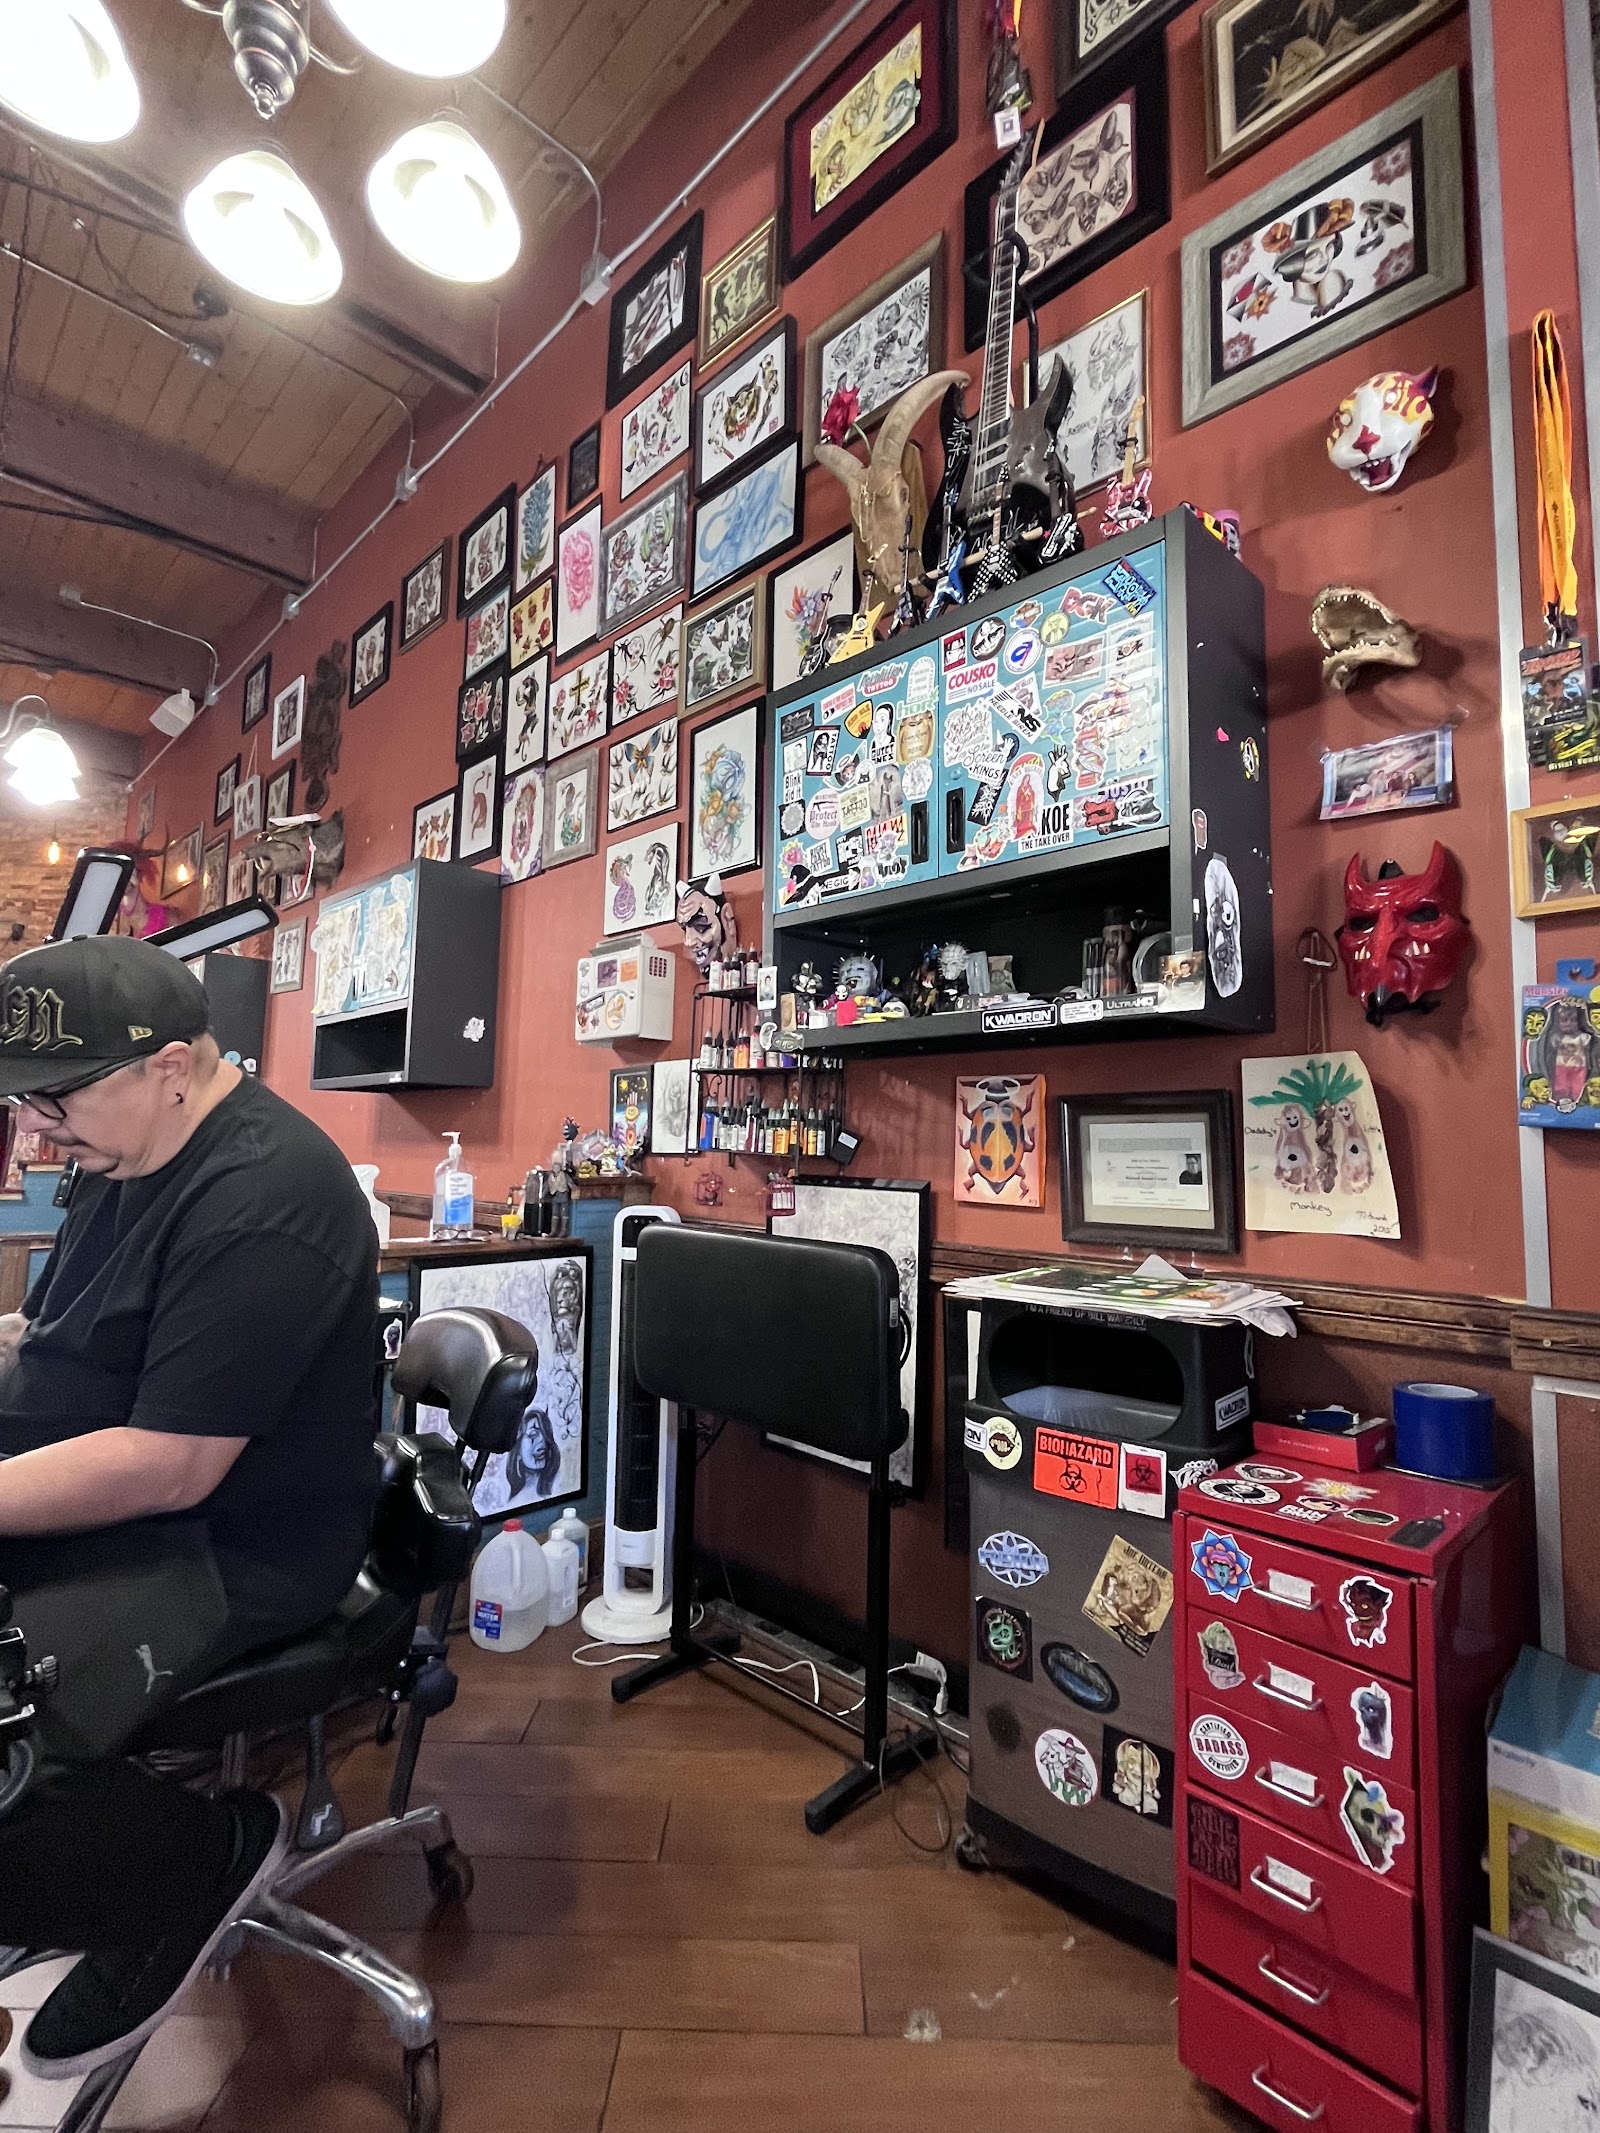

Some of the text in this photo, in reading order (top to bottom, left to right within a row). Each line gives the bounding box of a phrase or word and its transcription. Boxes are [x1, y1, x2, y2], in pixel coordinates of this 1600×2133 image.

[948, 662, 996, 690] COUSKO
[866, 679, 894, 693] TATTOO
[967, 680, 996, 694] NO SALE
[1012, 720, 1034, 738] SIREN
[825, 732, 838, 771] TATTOO
[963, 745, 1004, 767] Screen
[973, 763, 1000, 779] KINGS
[784, 772, 802, 789] Blink
[809, 810, 838, 822] Protect
[841, 798, 868, 818] TATTOO
[1021, 832, 1070, 850] THE TAKE OVER
[834, 877, 849, 887] GIG
[985, 1009, 1051, 1028] KWADRON
[1244, 1126, 1277, 1138] Daddy's
[1289, 1201, 1332, 1217] Monkey
[1373, 1224, 1391, 1234] 2015
[1045, 1306, 1073, 1317] FRIEND
[1074, 1309, 1085, 1319] OF
[1087, 1311, 1105, 1322] BILL
[1039, 1434, 1113, 1466] BIOHAZARD
[1199, 1722, 1232, 1739] CERTIFIED
[1195, 1737, 1244, 1756] BADASS
[1207, 1756, 1240, 1772] CERTIFIED
